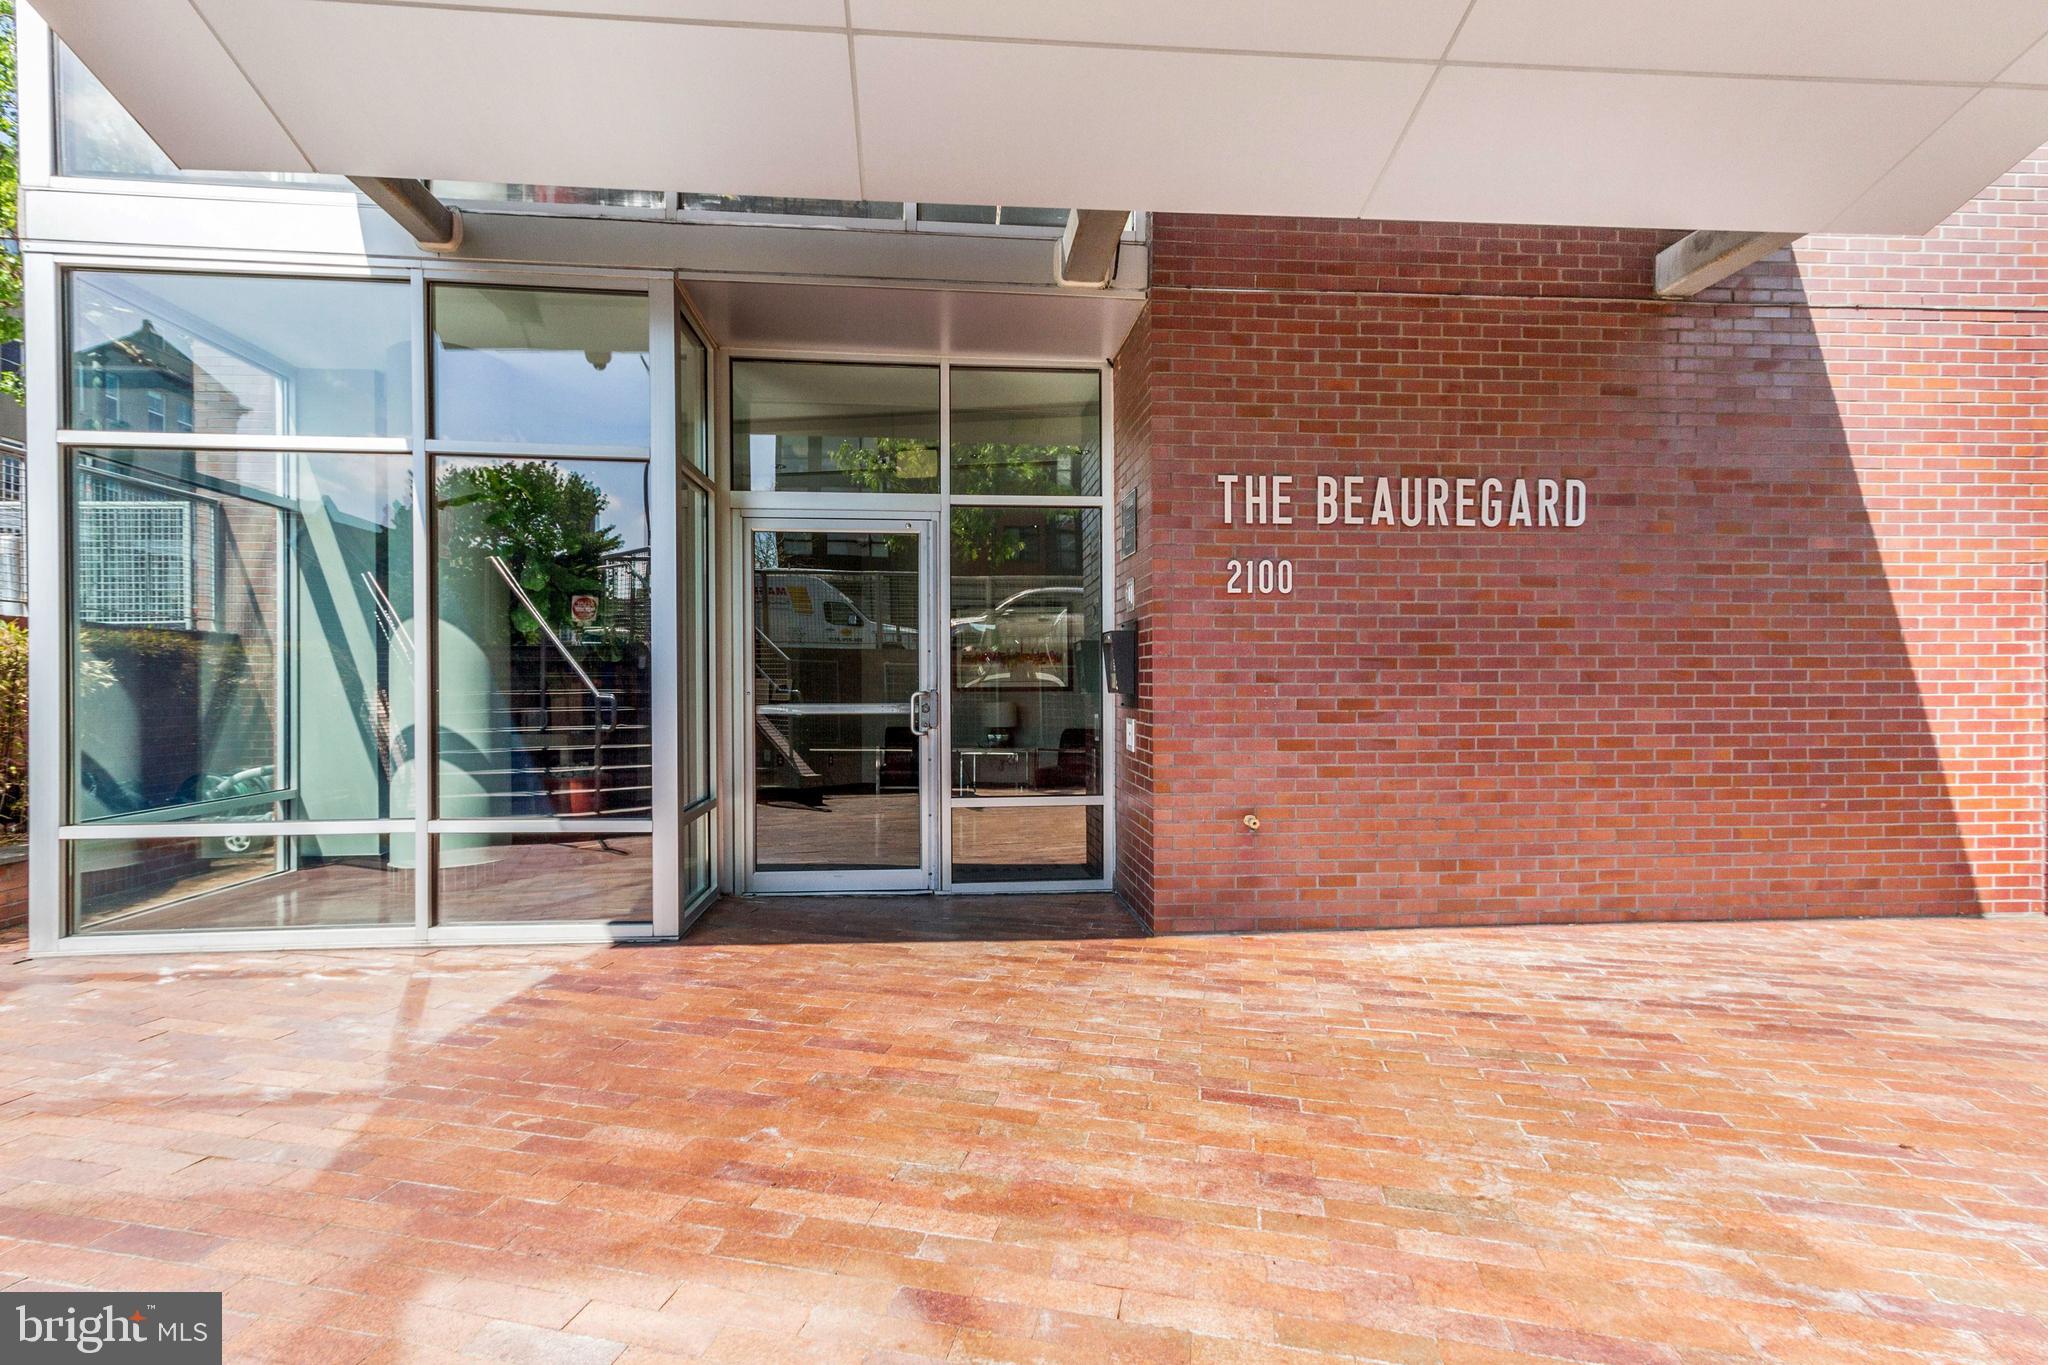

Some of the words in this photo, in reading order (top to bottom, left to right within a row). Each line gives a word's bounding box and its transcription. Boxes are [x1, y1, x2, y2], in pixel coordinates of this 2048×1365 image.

[1217, 474, 1293, 524] THE
[1316, 475, 1587, 528] BEAUREGARD
[1226, 560, 1294, 594] 2100
